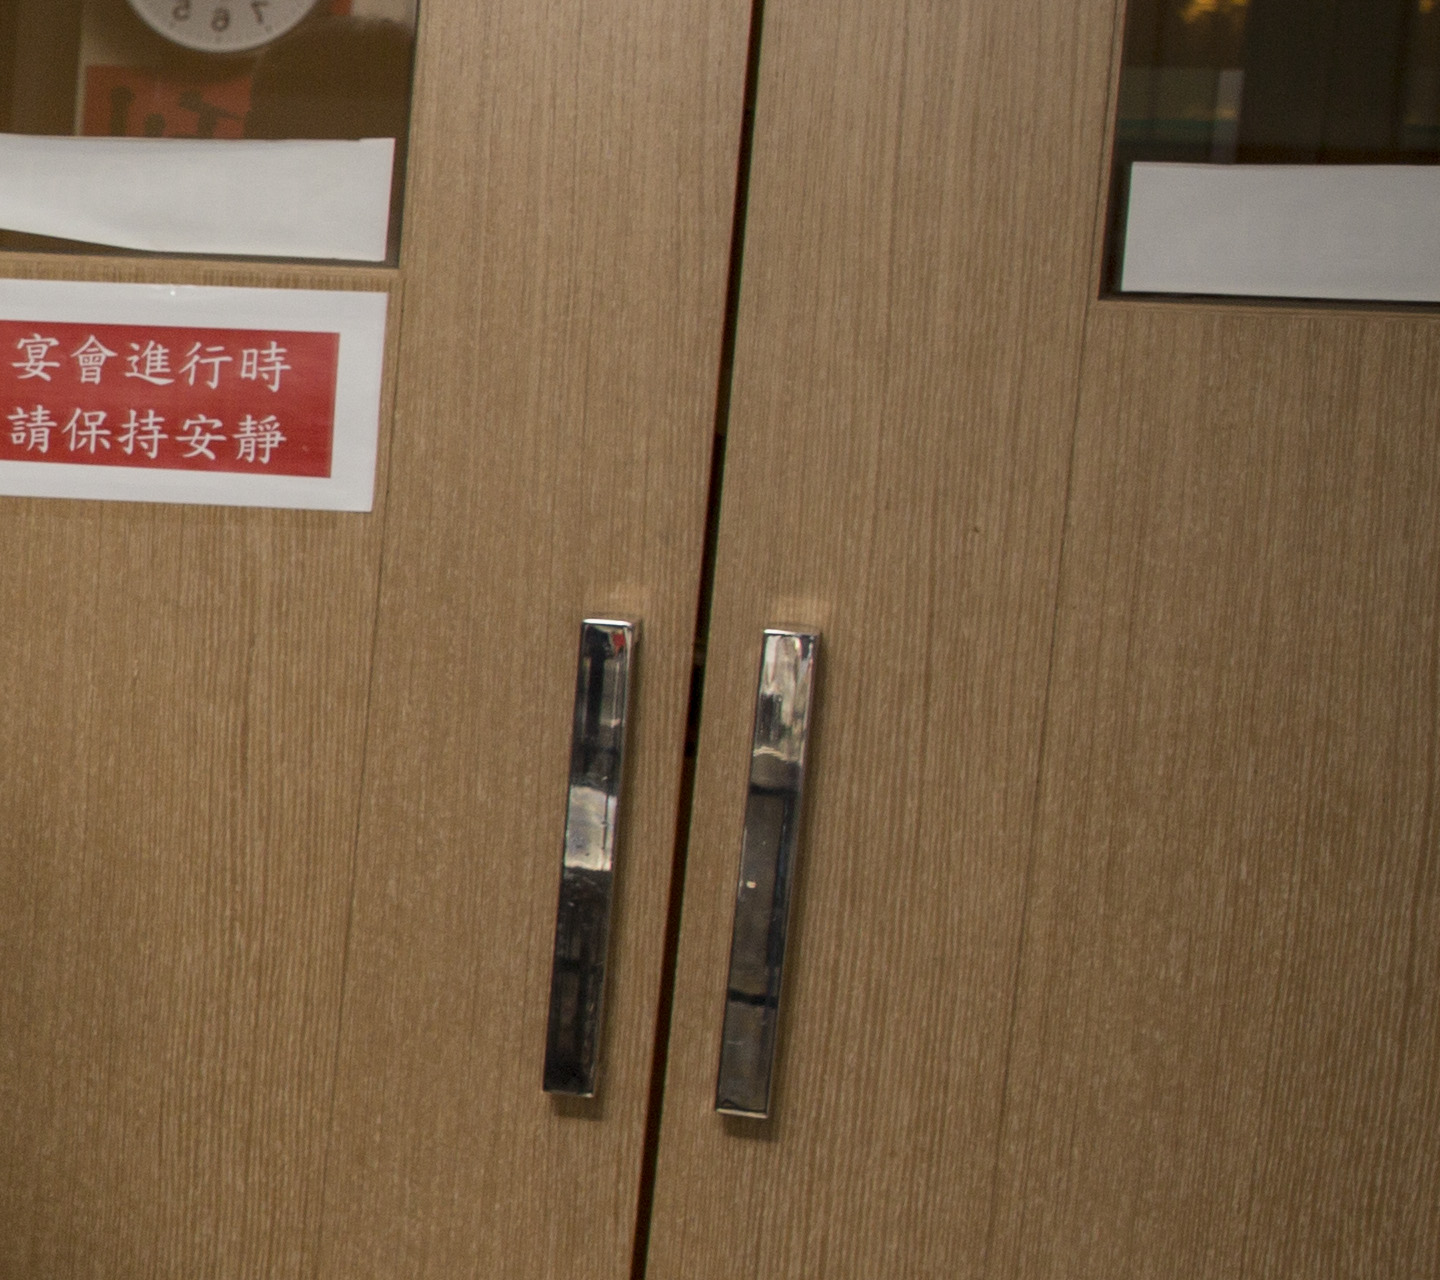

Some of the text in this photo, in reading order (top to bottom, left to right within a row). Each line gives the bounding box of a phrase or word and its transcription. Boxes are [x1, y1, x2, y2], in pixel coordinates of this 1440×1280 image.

[12, 333, 292, 394] 宴會進行時
[7, 405, 287, 465] 請保持安靜
